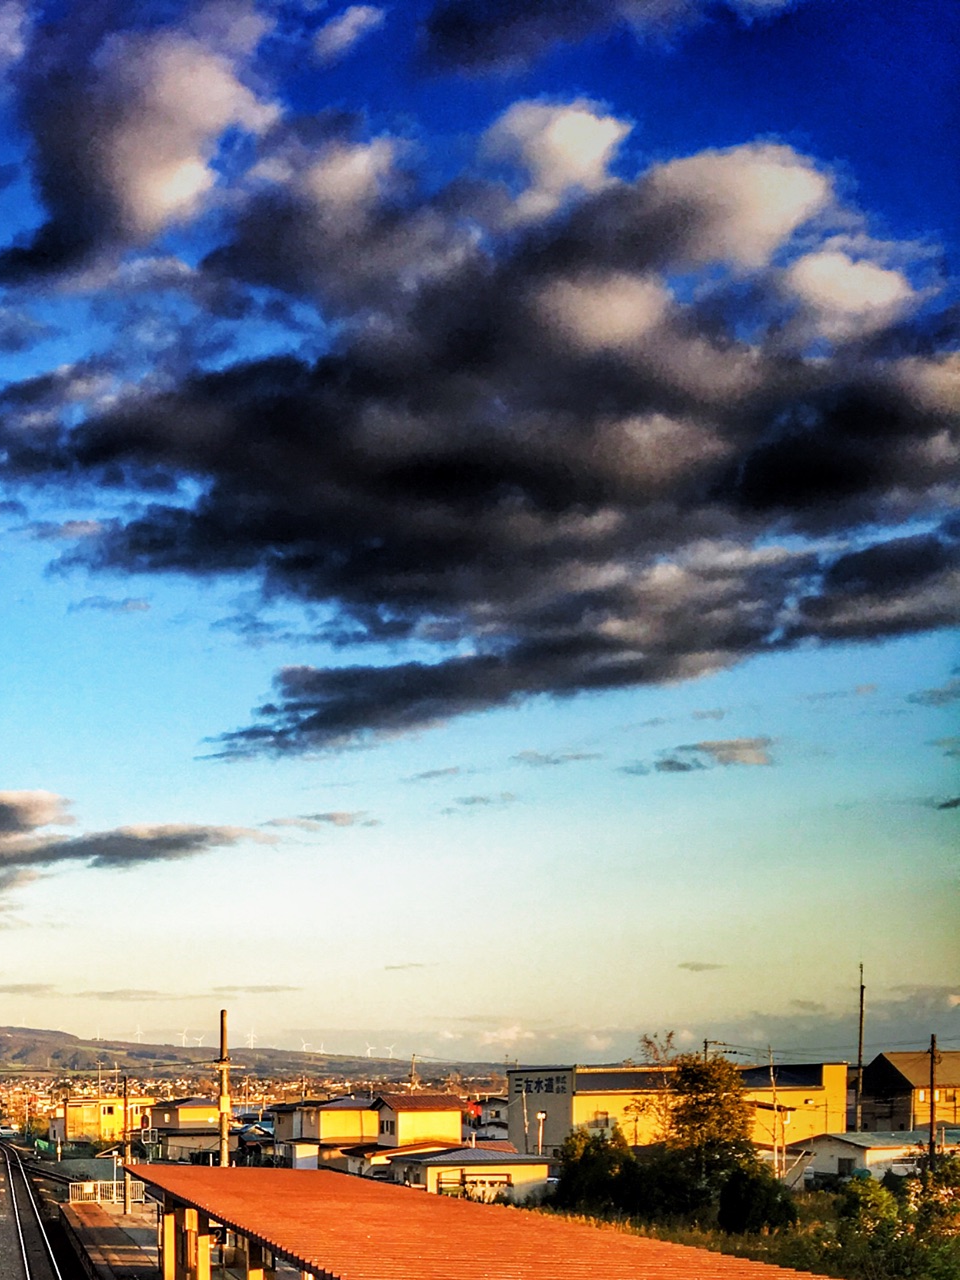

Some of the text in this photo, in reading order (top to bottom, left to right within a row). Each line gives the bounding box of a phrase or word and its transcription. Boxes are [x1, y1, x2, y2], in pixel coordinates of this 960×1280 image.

[514, 1077, 554, 1093] 三友水道
[213, 1229, 222, 1242] 2
